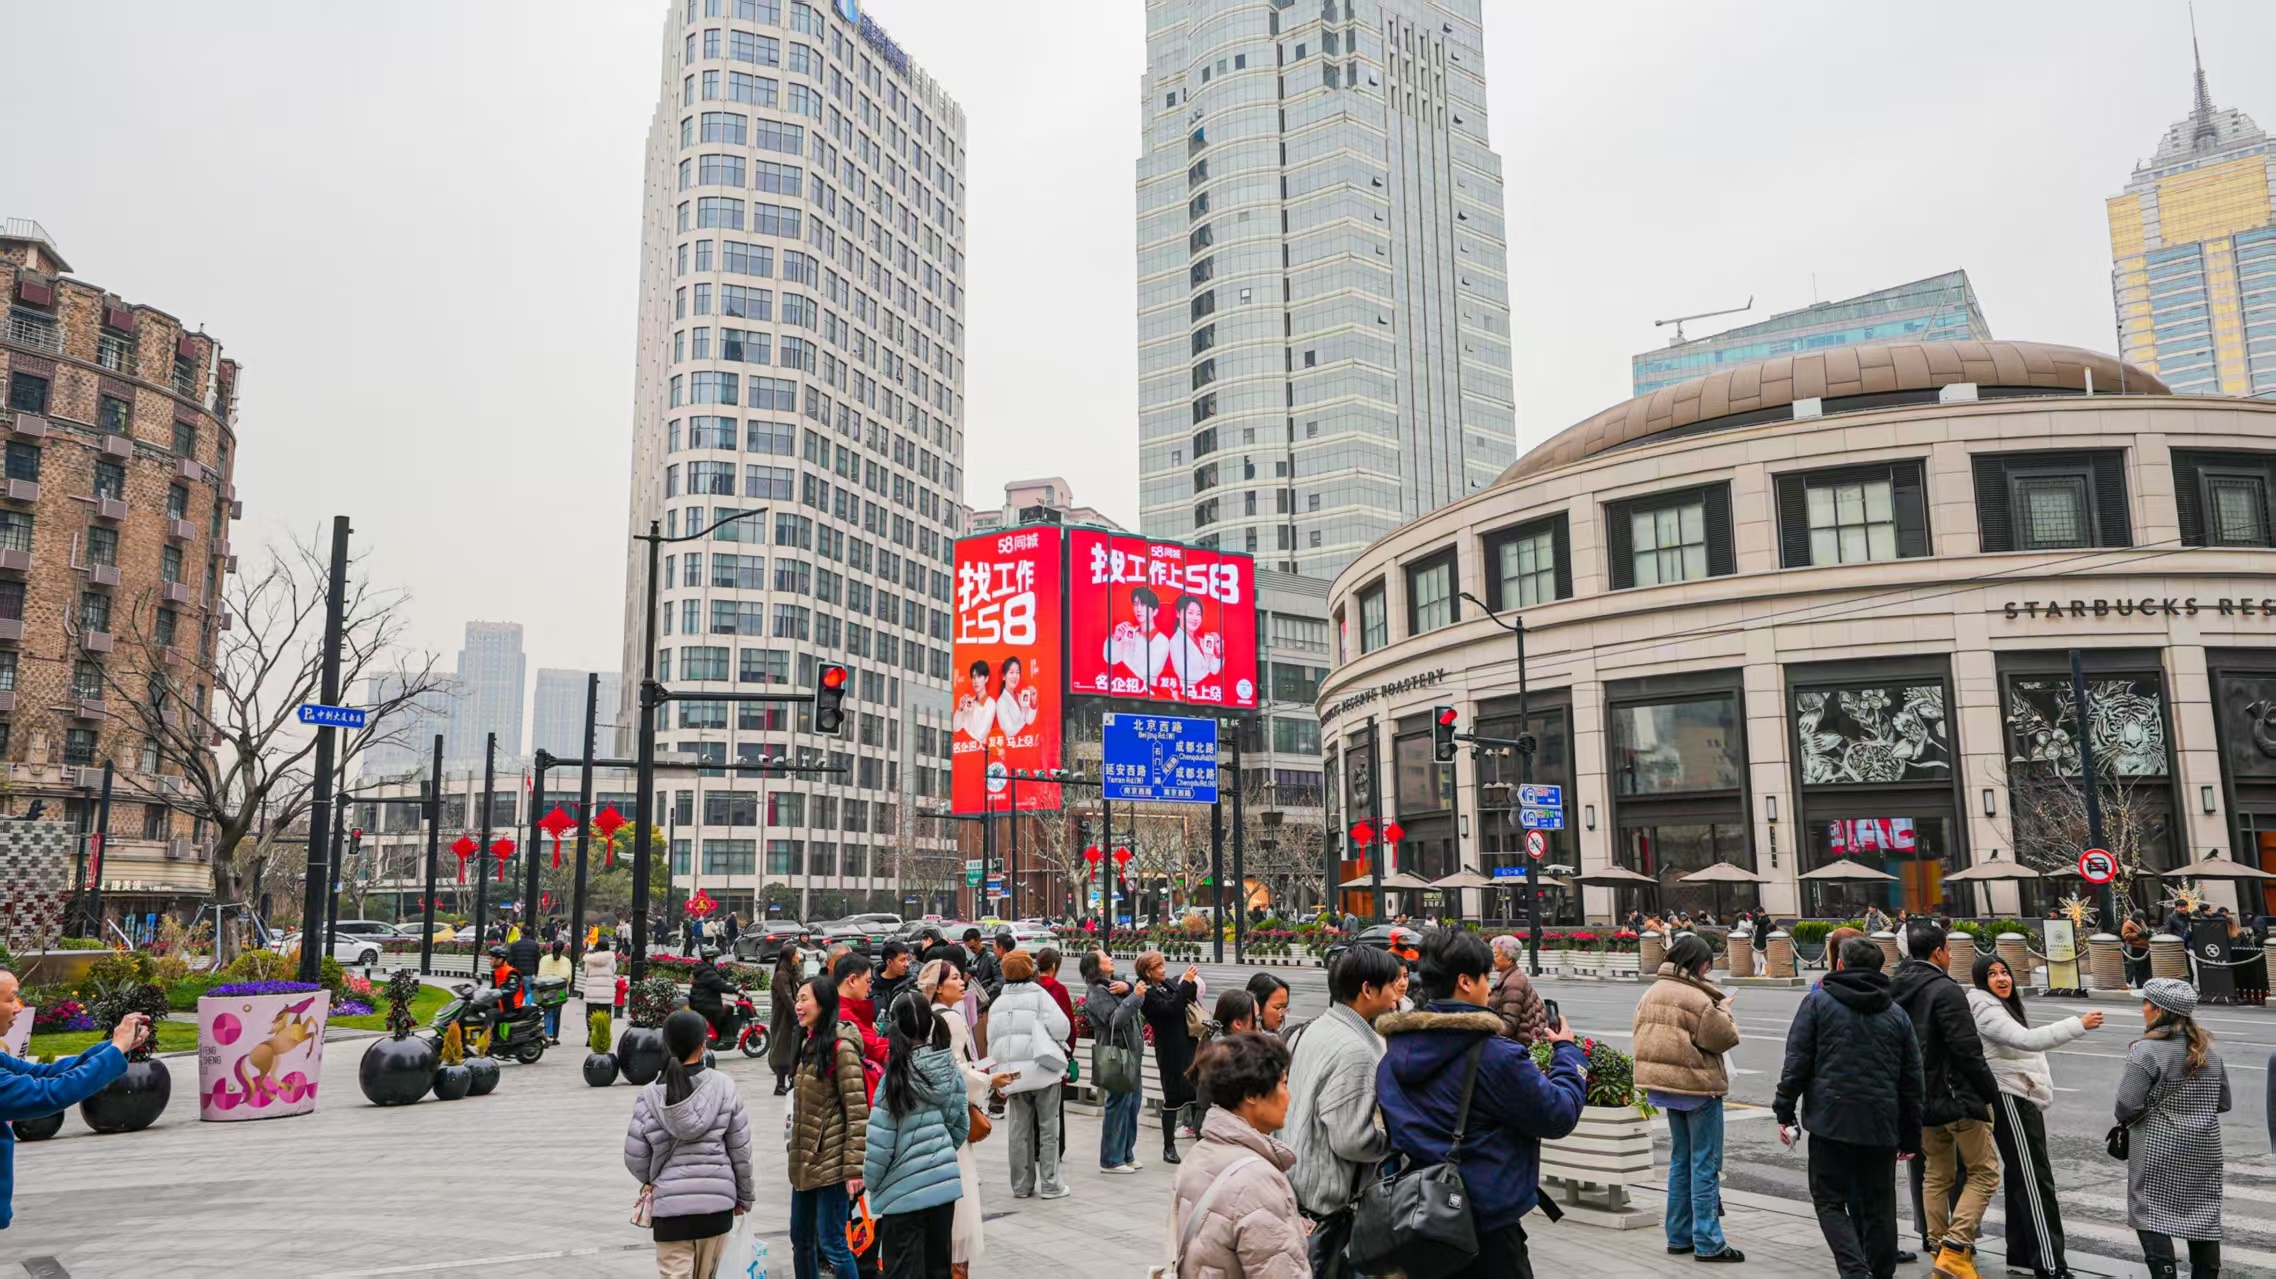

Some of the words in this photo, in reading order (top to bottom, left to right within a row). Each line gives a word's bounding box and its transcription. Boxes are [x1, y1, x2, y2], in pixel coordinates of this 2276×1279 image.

[998, 533, 1038, 554] 58同城
[1151, 546, 1181, 559] 58同城
[1091, 542, 1240, 604] 找工作上58
[958, 560, 1035, 613] 找工作
[956, 591, 1036, 645] 上58
[2004, 597, 2199, 620] STARBUCKS
[1381, 668, 1444, 698] ROASTERY
[1133, 719, 1182, 734] 北京西路
[1175, 741, 1214, 754] 成都北路
[1105, 763, 1146, 777] 延安西路
[1175, 767, 1215, 780] 成都北路
